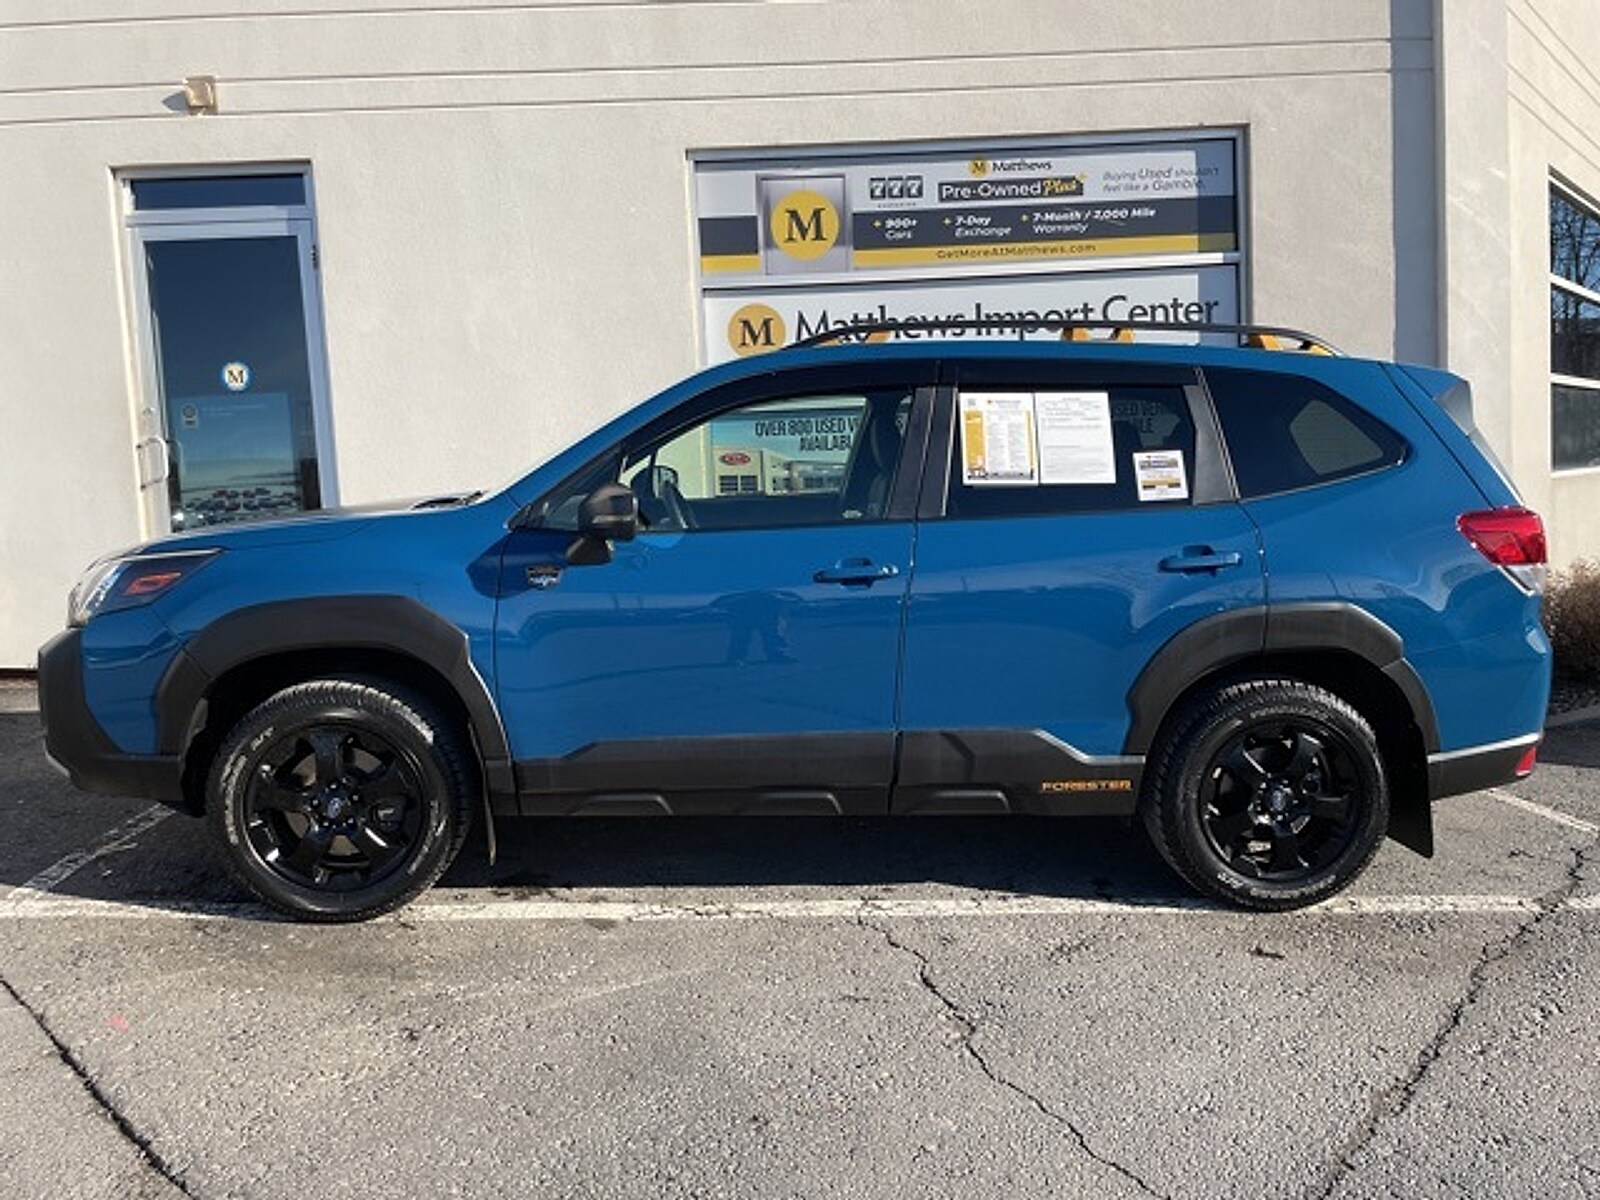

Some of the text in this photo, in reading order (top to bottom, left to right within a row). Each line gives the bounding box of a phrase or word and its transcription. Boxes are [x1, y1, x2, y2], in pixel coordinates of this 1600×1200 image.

[992, 159, 1052, 172] Matthews
[1103, 171, 1136, 181] Buying
[1138, 167, 1172, 179] Used
[941, 178, 1079, 201] Pre-Owned Plus
[1103, 183, 1121, 192] feel
[1124, 182, 1140, 191] like
[955, 215, 992, 228] 7-Day
[1033, 208, 1083, 222] 7-Month
[1131, 207, 1156, 218] Mile
[785, 207, 827, 243] M
[955, 225, 1012, 238] Exchange
[1033, 222, 1088, 236] Warranty
[884, 230, 913, 241] Cars
[937, 243, 1096, 260] GetMoreAtMatthews.com
[739, 317, 775, 347] M
[1102, 295, 1219, 326] Center
[227, 370, 244, 384] M
[755, 420, 786, 437] OVER
[815, 418, 846, 434] USED
[1042, 779, 1133, 792] FORESTER
